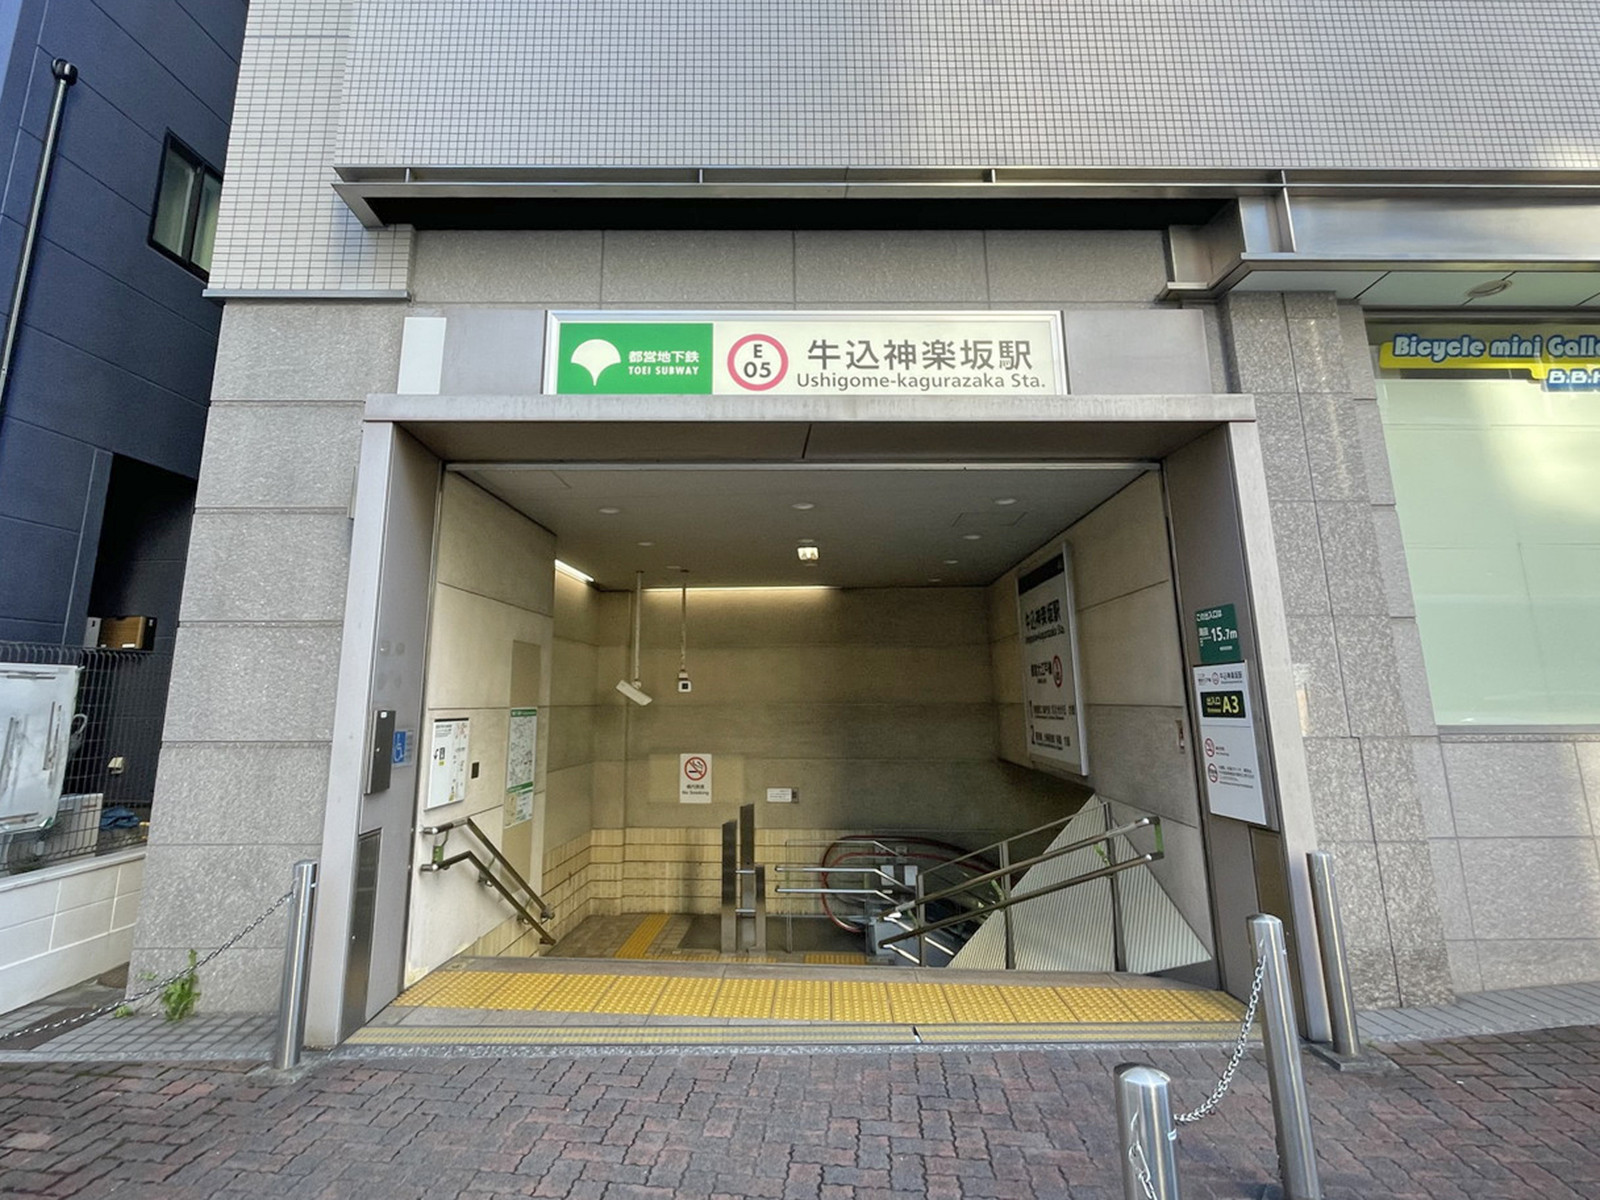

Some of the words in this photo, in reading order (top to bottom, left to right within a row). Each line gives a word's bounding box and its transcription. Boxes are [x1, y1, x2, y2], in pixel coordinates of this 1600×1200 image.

[753, 344, 762, 359] E
[807, 339, 1033, 370] 牛込神楽坂駅
[1394, 334, 1485, 362] Bicycle
[1490, 335, 1541, 357] mini
[629, 351, 699, 363] 都営地下鉄
[628, 366, 651, 375] TOEI
[656, 366, 699, 375] SUBWAY
[744, 362, 771, 378] 05
[797, 373, 1005, 391] Ushigome-kagurazaka
[1011, 373, 1046, 388] Sta.
[1211, 626, 1238, 642] 15.7m
[1222, 695, 1239, 713] A3
